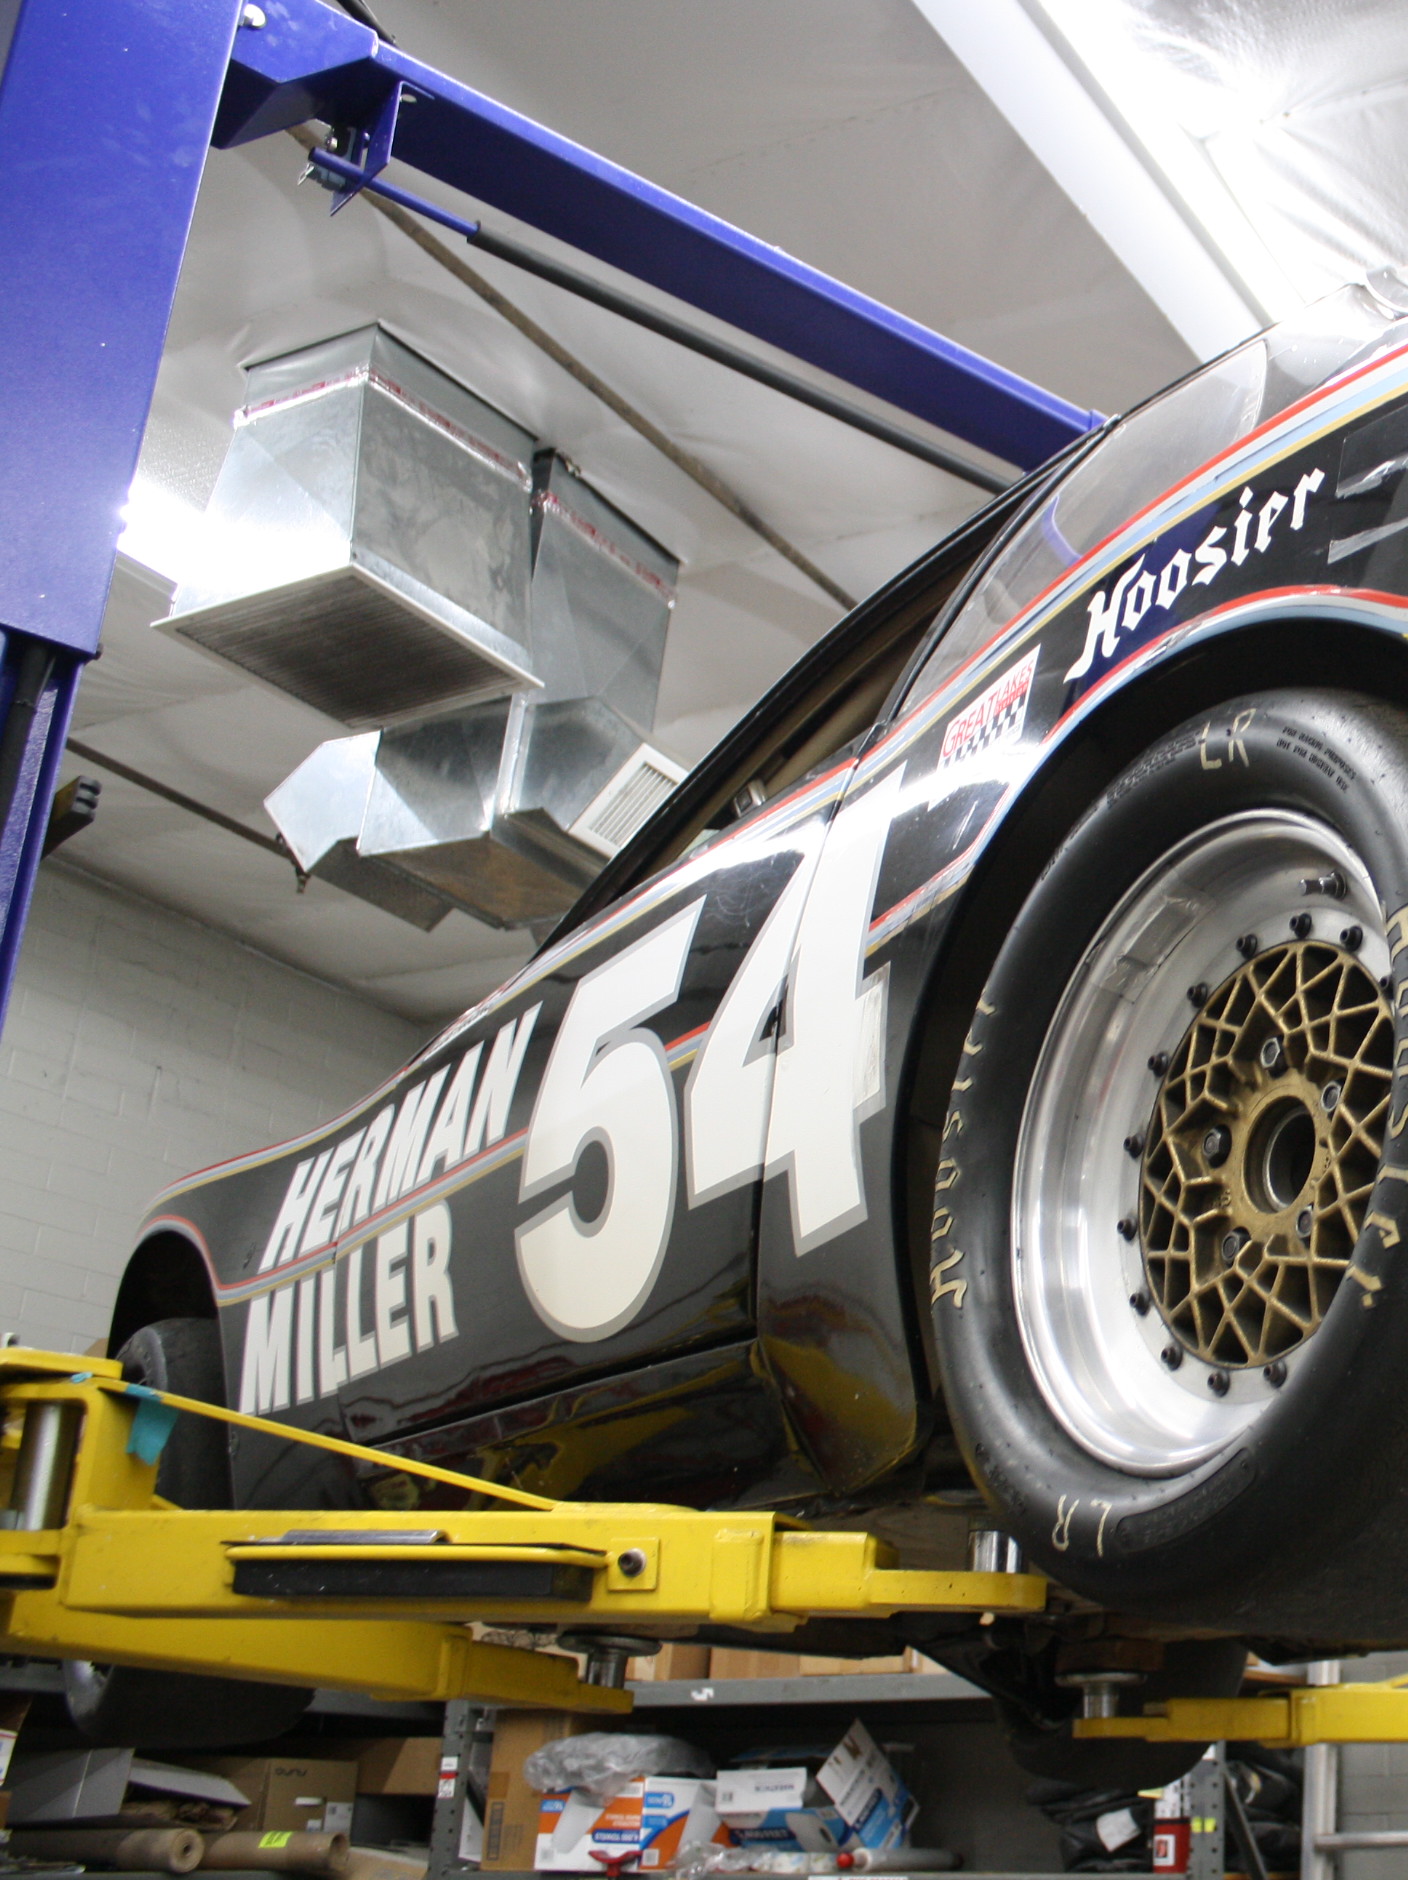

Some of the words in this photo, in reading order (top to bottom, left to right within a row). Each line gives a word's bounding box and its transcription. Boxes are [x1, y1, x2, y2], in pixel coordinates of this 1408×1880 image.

[1063, 468, 1326, 684] Hoosier
[943, 690, 999, 758] GREAT
[995, 660, 1034, 704] LAKES
[1201, 708, 1257, 770] LR
[257, 1000, 543, 1275] HERMAN
[514, 759, 908, 1342] 54
[238, 1198, 459, 1416] MILLER
